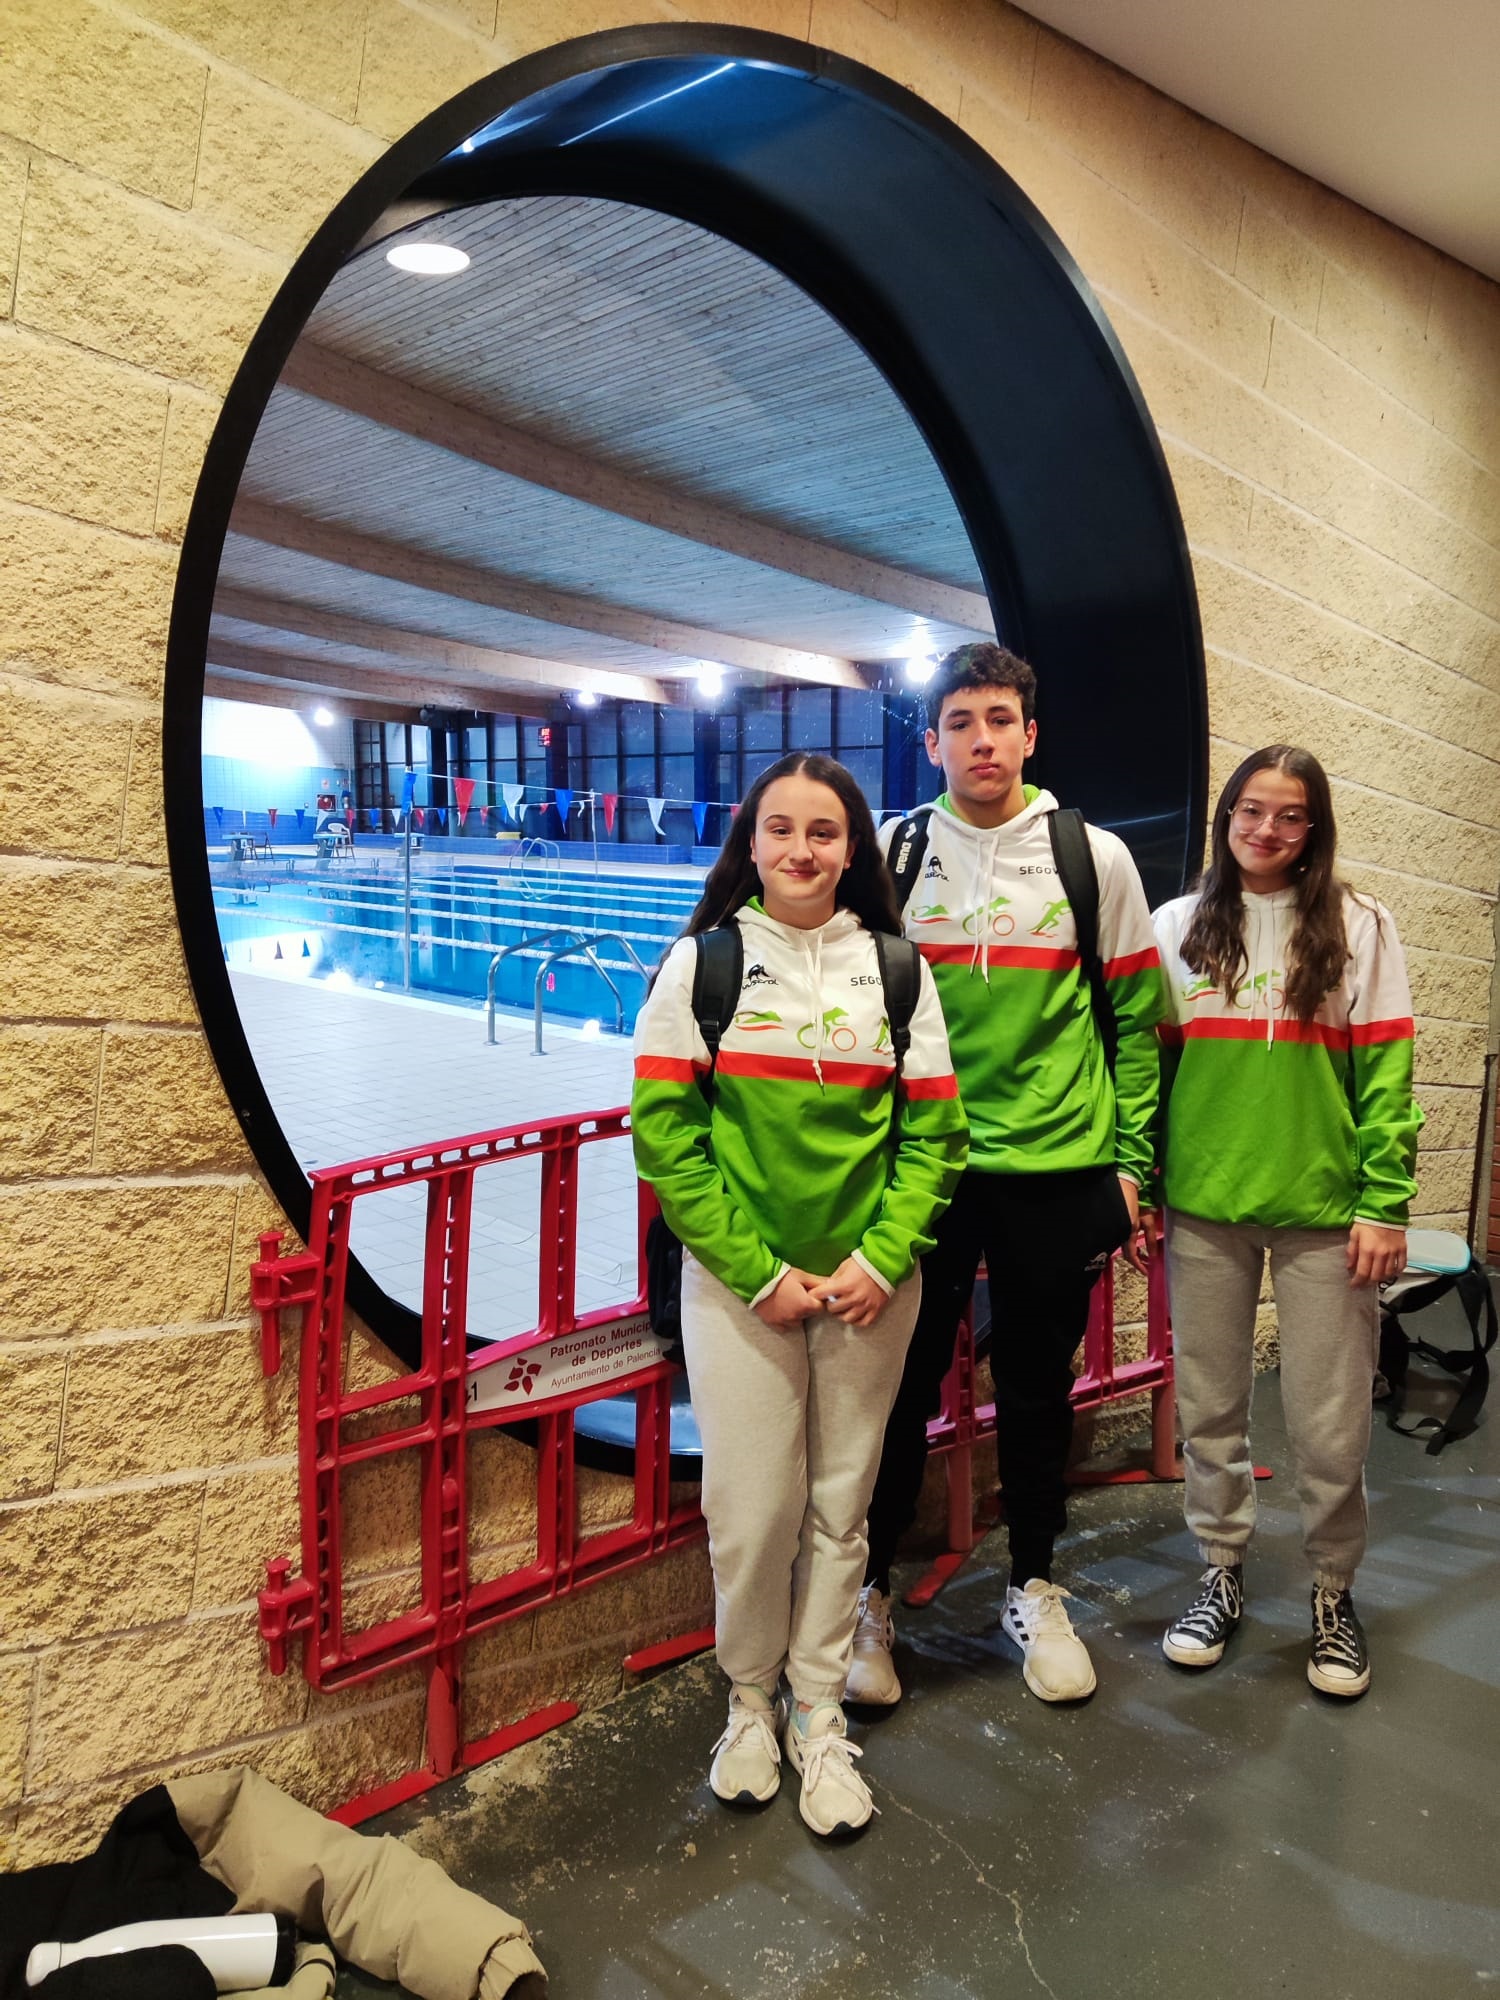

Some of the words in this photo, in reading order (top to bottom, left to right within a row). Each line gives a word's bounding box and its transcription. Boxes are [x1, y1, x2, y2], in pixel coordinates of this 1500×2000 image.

[895, 841, 913, 874] arena
[550, 1335, 606, 1359] Patronato
[571, 1355, 586, 1367] de
[591, 1339, 642, 1362] Deportes
[550, 1365, 610, 1388] Ayuntamiento
[613, 1359, 624, 1369] de
[627, 1348, 661, 1366] Palencia
